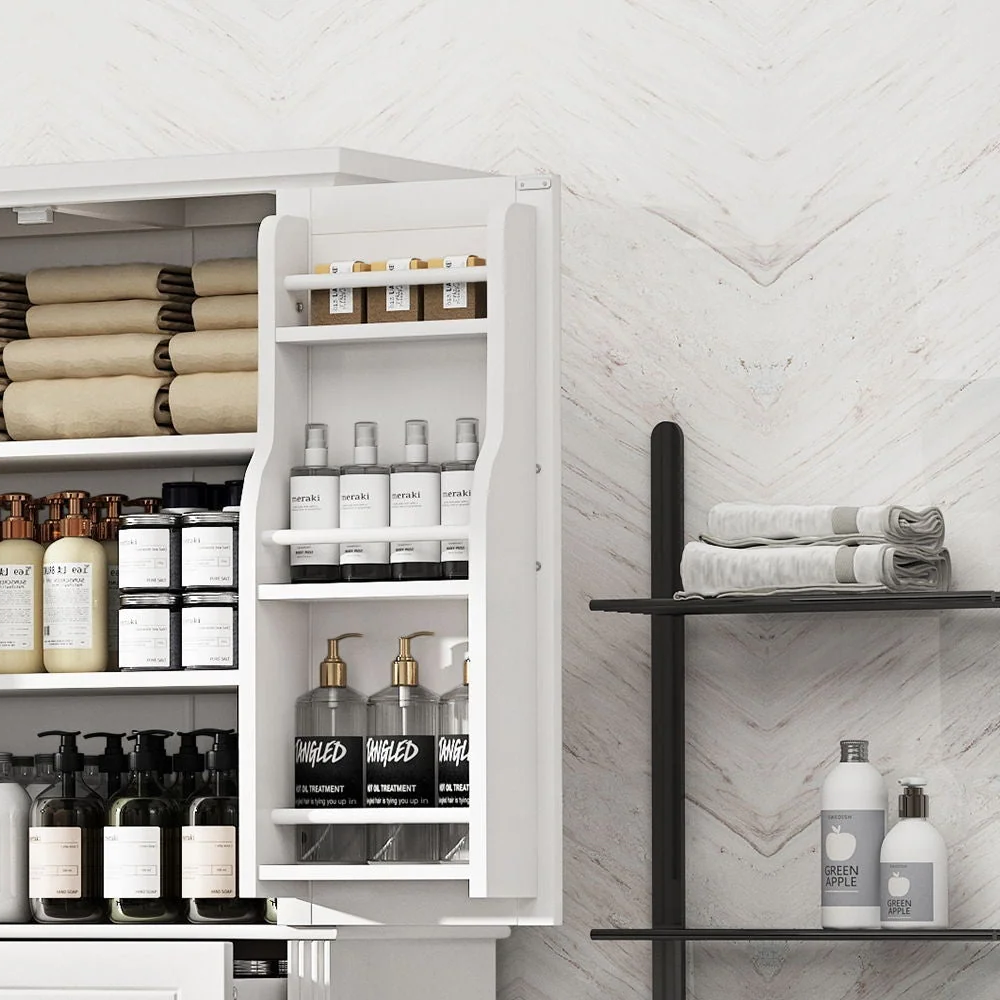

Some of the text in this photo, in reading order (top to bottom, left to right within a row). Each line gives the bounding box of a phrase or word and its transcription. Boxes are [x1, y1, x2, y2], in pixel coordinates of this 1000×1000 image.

[309, 785, 345, 793] TREATMENT
[380, 784, 417, 792] TREATMENT
[825, 865, 859, 876] GREEN
[825, 877, 857, 887] APPLE
